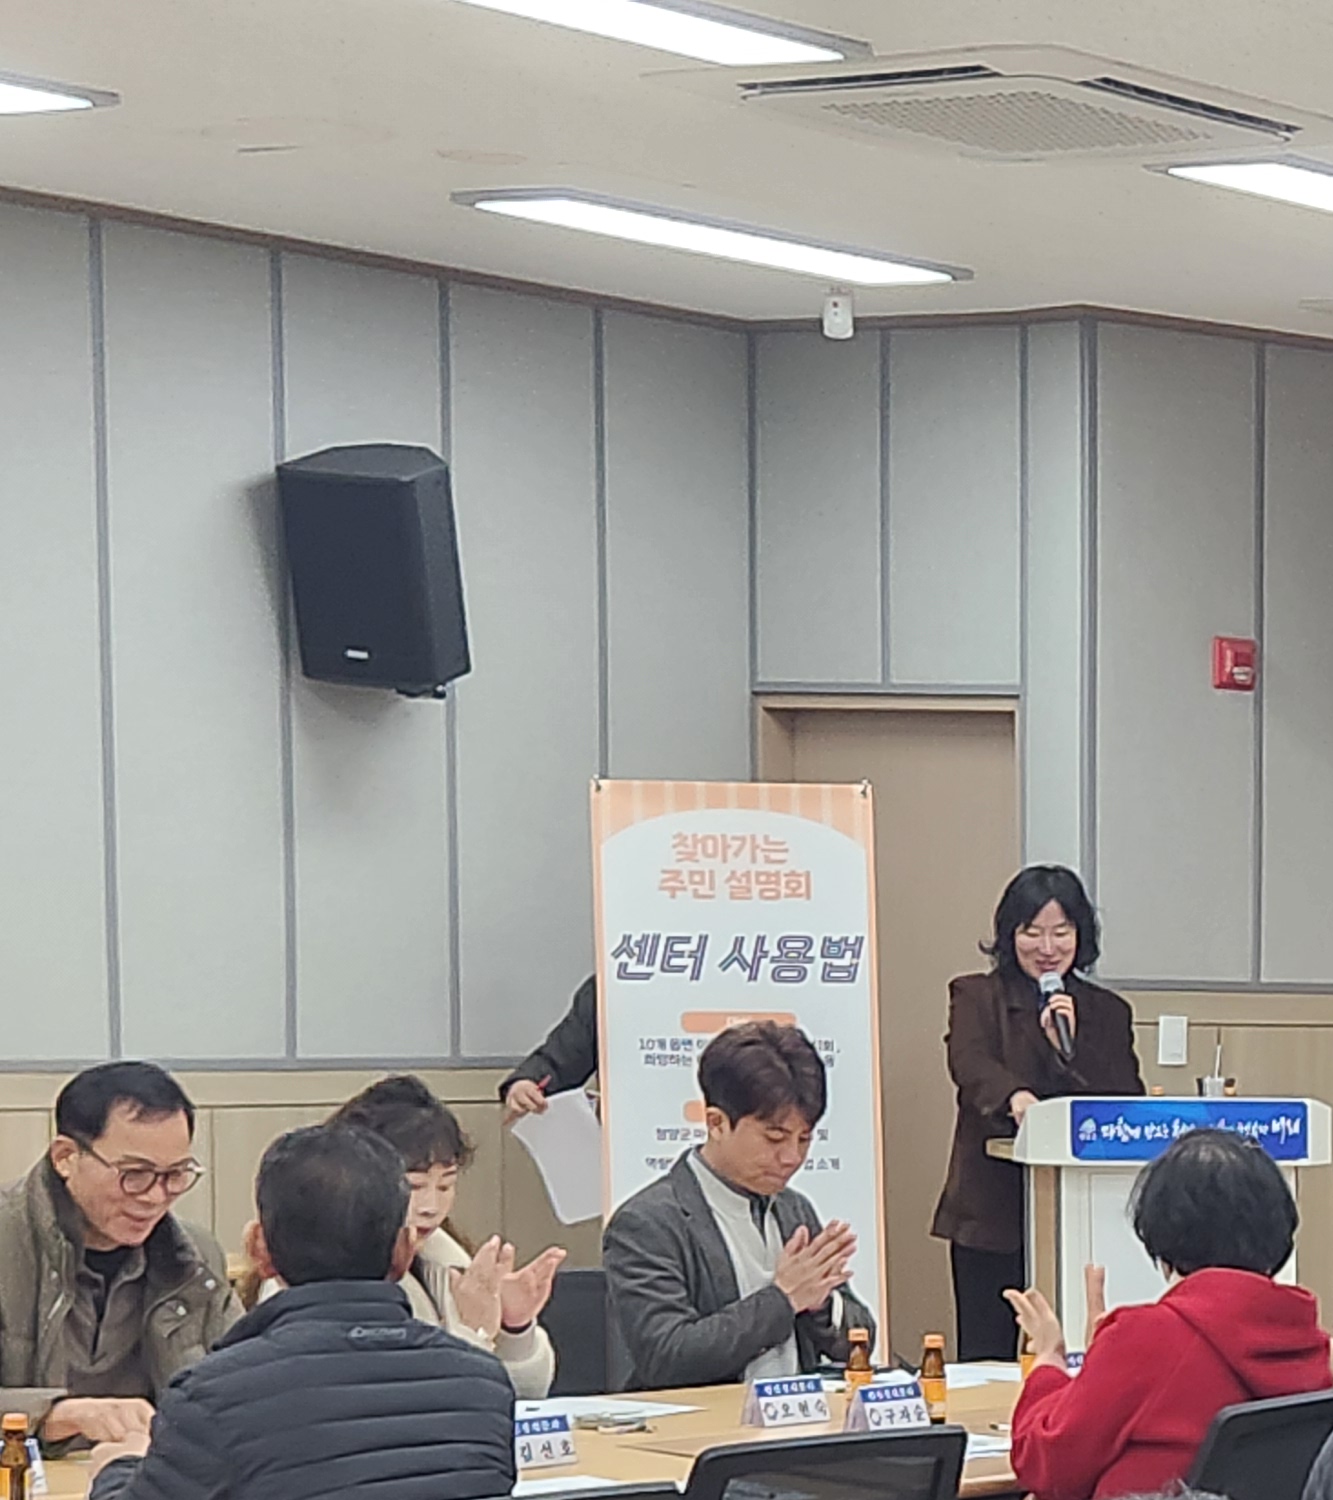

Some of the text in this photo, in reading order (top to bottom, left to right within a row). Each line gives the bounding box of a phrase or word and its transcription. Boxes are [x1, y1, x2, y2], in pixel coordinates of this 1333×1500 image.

[670, 832, 789, 864] 찾아가는
[658, 869, 812, 900] 주민 설명회
[611, 932, 865, 984] 센터 사용법
